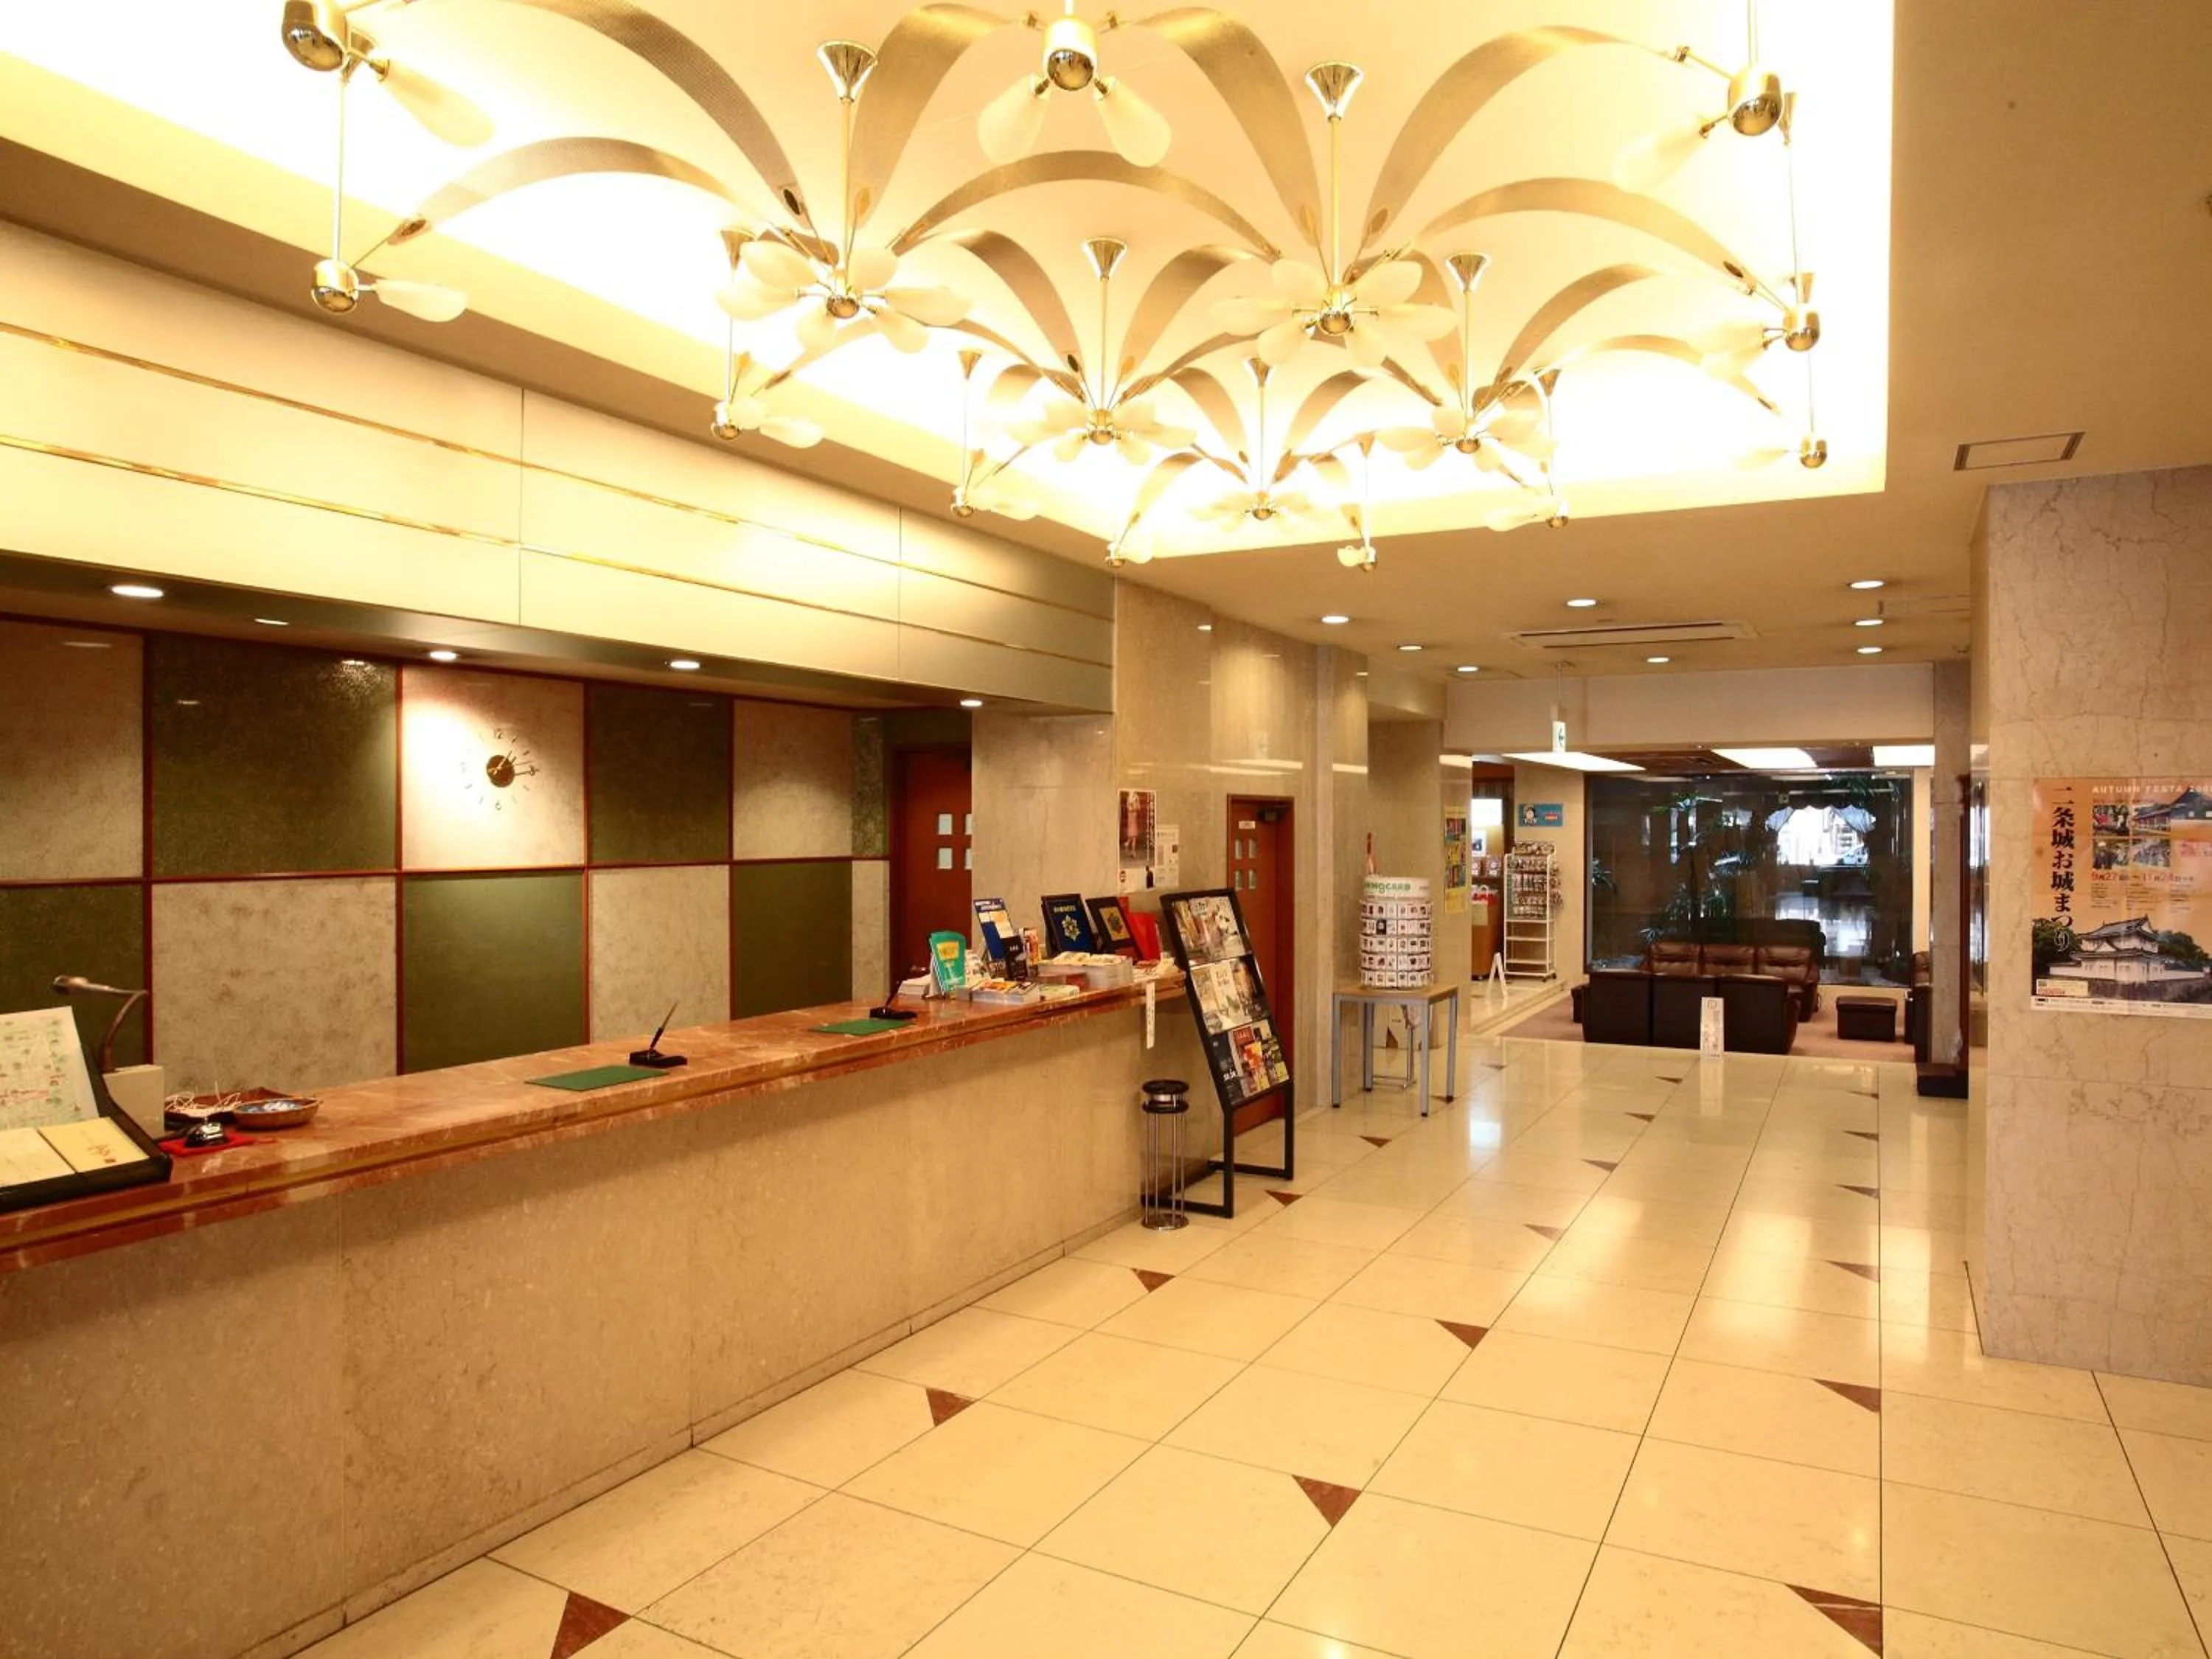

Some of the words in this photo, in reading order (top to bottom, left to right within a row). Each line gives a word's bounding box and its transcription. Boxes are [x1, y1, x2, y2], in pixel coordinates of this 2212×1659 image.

[2092, 785, 2140, 793] AUTUMN
[2051, 786, 2075, 951] 二条城お城まつり
